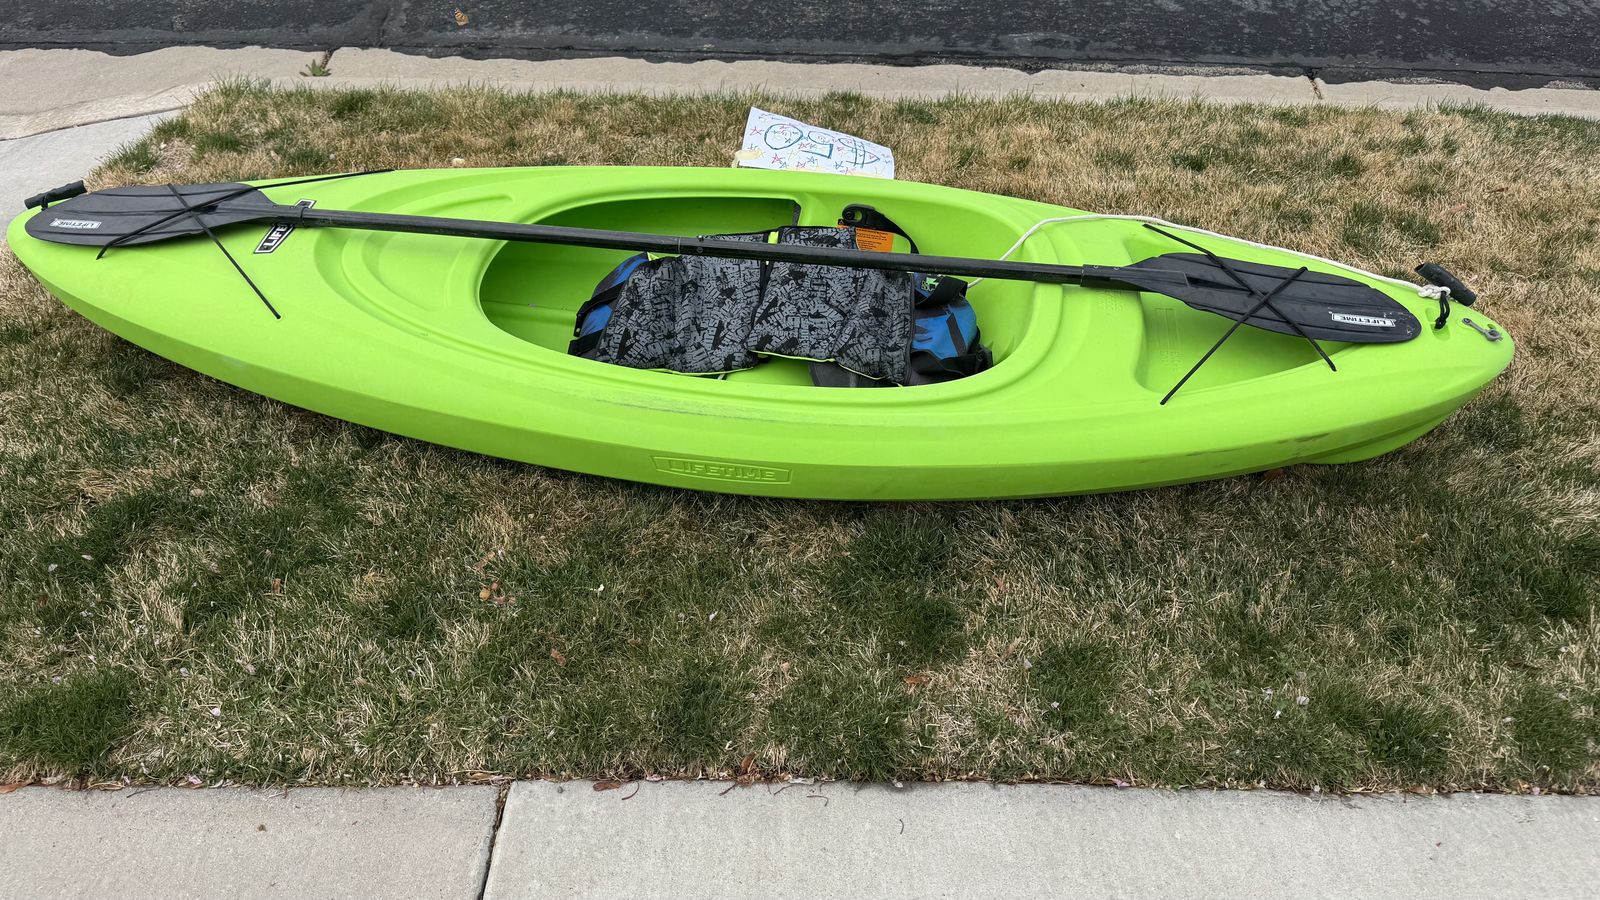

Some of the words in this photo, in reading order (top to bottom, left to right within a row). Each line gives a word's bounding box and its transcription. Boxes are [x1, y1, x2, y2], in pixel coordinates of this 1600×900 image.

[57, 220, 95, 229] LIFETIME
[1339, 315, 1387, 325] LIFETIME
[668, 459, 776, 481] LIFETIME
